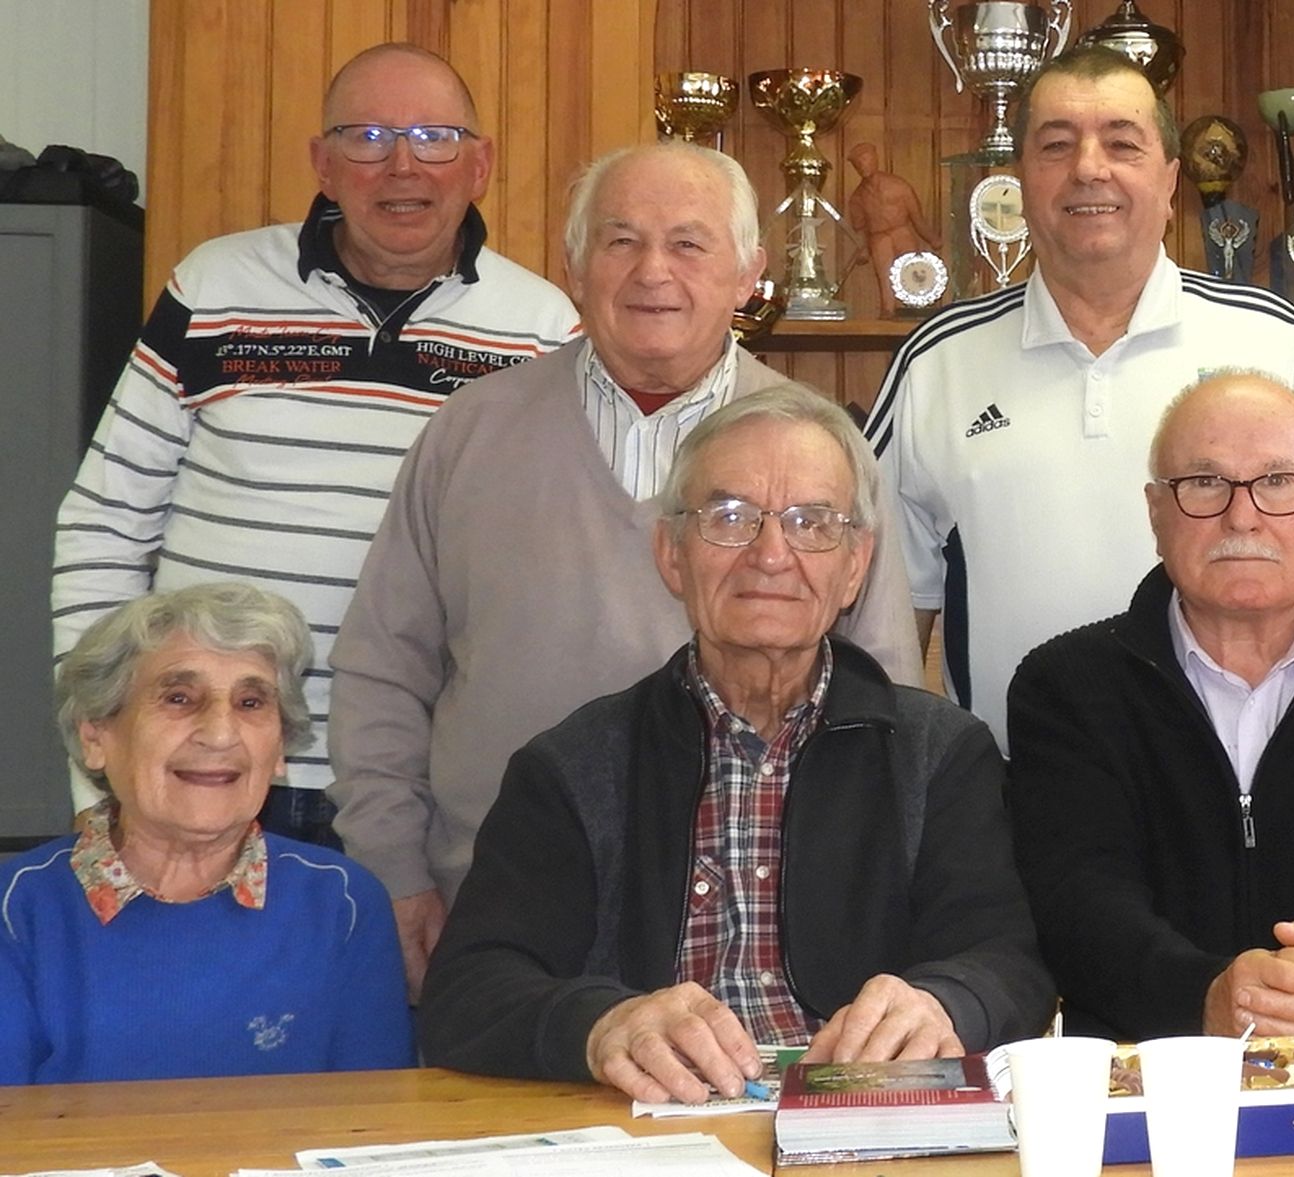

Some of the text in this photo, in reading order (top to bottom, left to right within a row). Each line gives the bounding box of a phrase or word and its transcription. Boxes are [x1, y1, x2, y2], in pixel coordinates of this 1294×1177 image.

[415, 341, 456, 360] HIGH
[458, 347, 507, 368] LEVEL
[222, 360, 342, 373] BREAK WATER
[965, 417, 1011, 438] adidas
